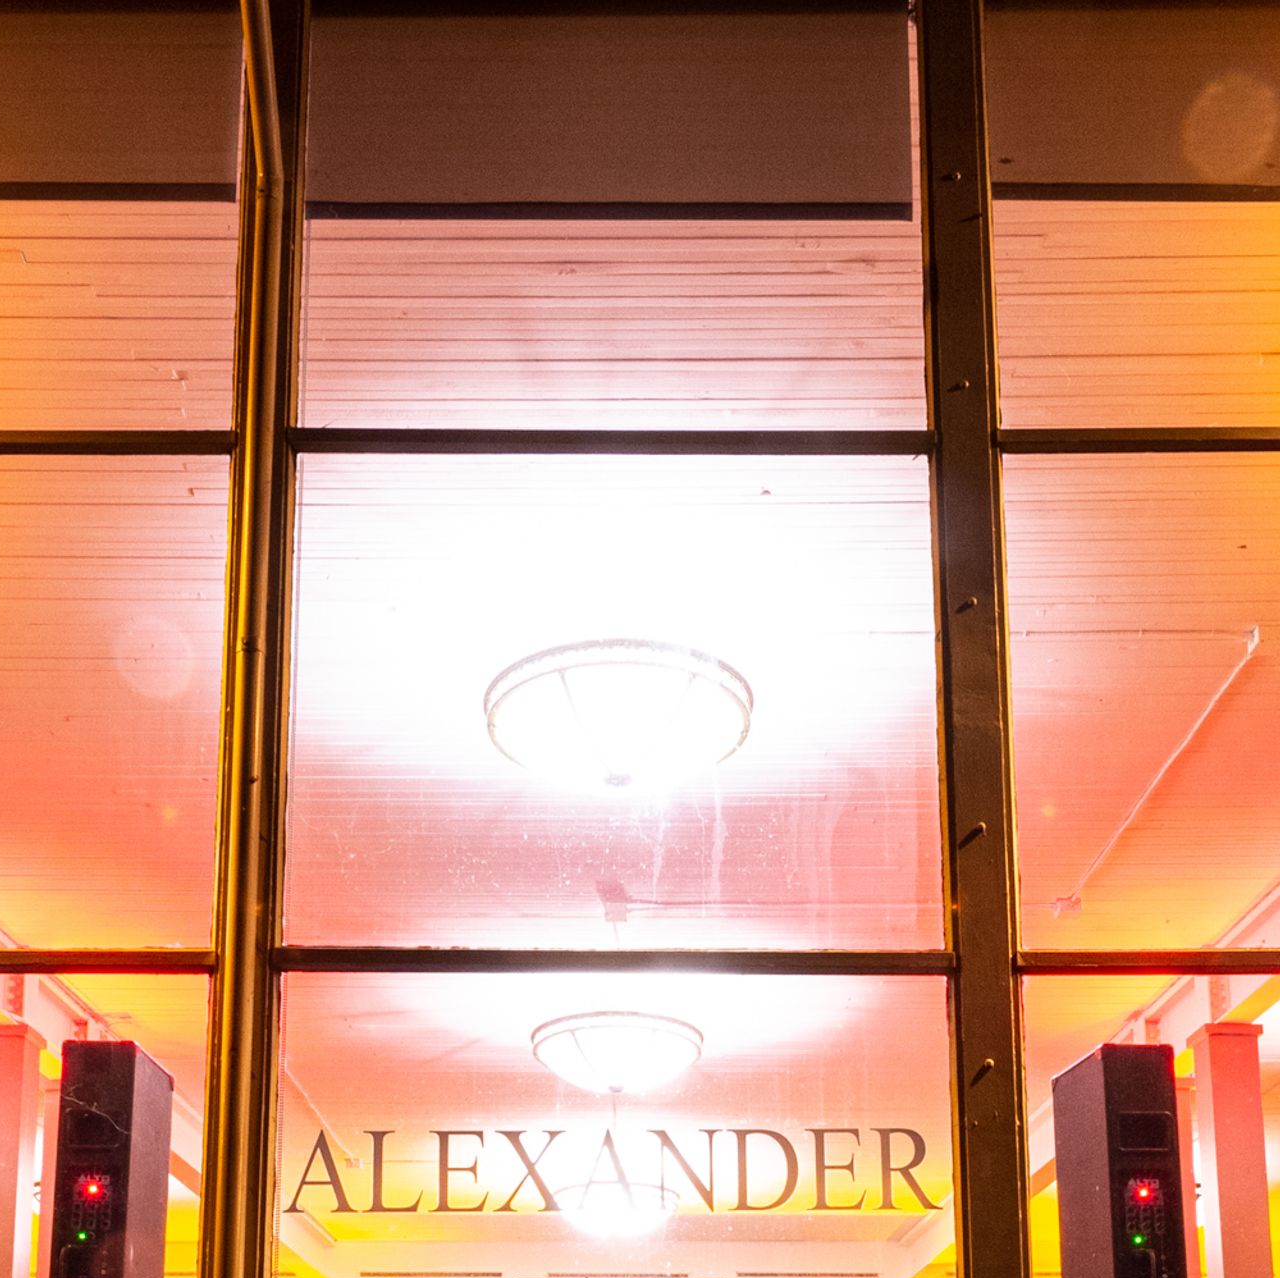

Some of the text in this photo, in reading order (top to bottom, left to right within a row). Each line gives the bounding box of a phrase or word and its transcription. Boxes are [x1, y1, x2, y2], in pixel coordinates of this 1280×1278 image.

[284, 1128, 943, 1214] ALEXANDER
[78, 1174, 110, 1185] ALTO
[1127, 1178, 1160, 1189] ALTO
